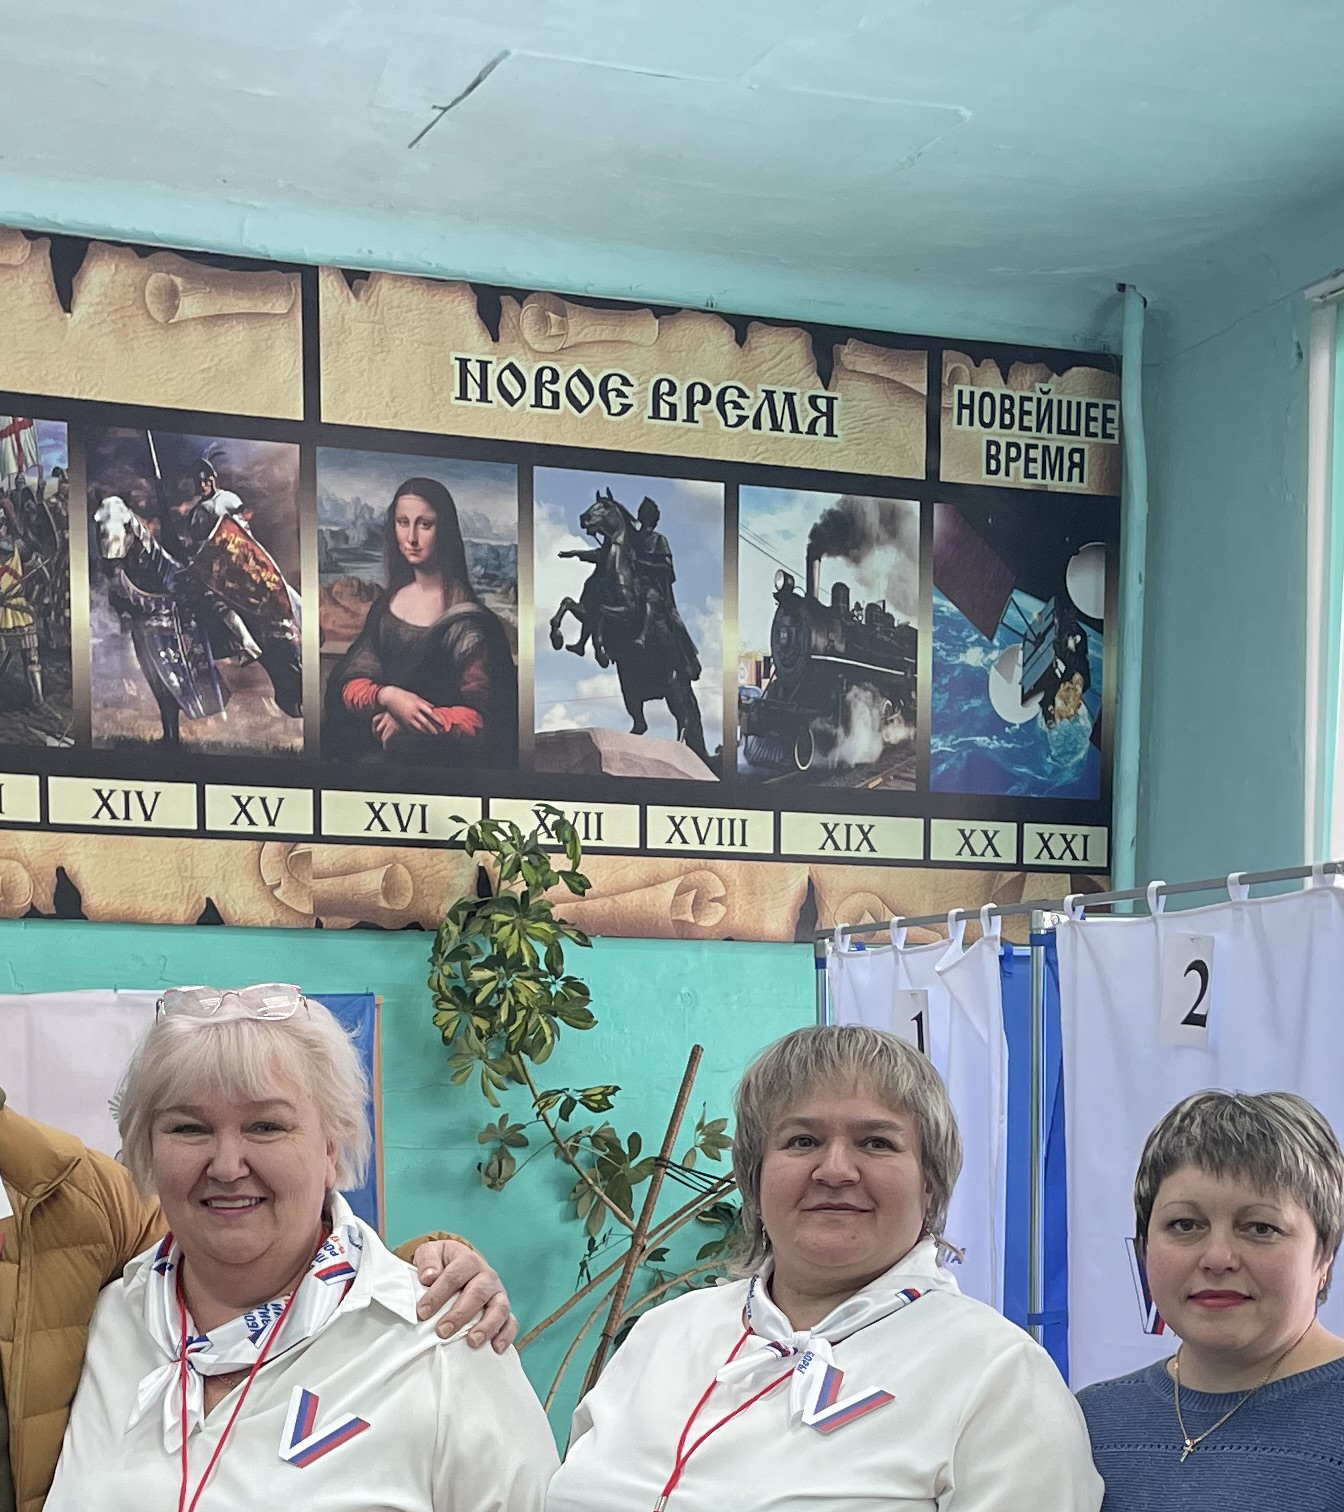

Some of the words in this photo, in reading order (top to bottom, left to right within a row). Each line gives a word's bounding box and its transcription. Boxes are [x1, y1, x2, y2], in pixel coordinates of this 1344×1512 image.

[454, 356, 635, 416] НОВОЕ
[648, 377, 839, 438] ВРЕМЯ
[956, 387, 1119, 440] НОВЕЙШЕЕ
[986, 439, 1085, 484] ВРЕМЯ
[90, 787, 162, 823] XIV
[230, 794, 286, 828] XV
[363, 800, 430, 834] XVI
[665, 815, 749, 848] XVIII
[818, 821, 878, 853] XIX
[955, 827, 1003, 860] XX
[1034, 831, 1091, 862] XXI
[1179, 959, 1210, 1028] 2
[910, 1010, 924, 1054] 1
